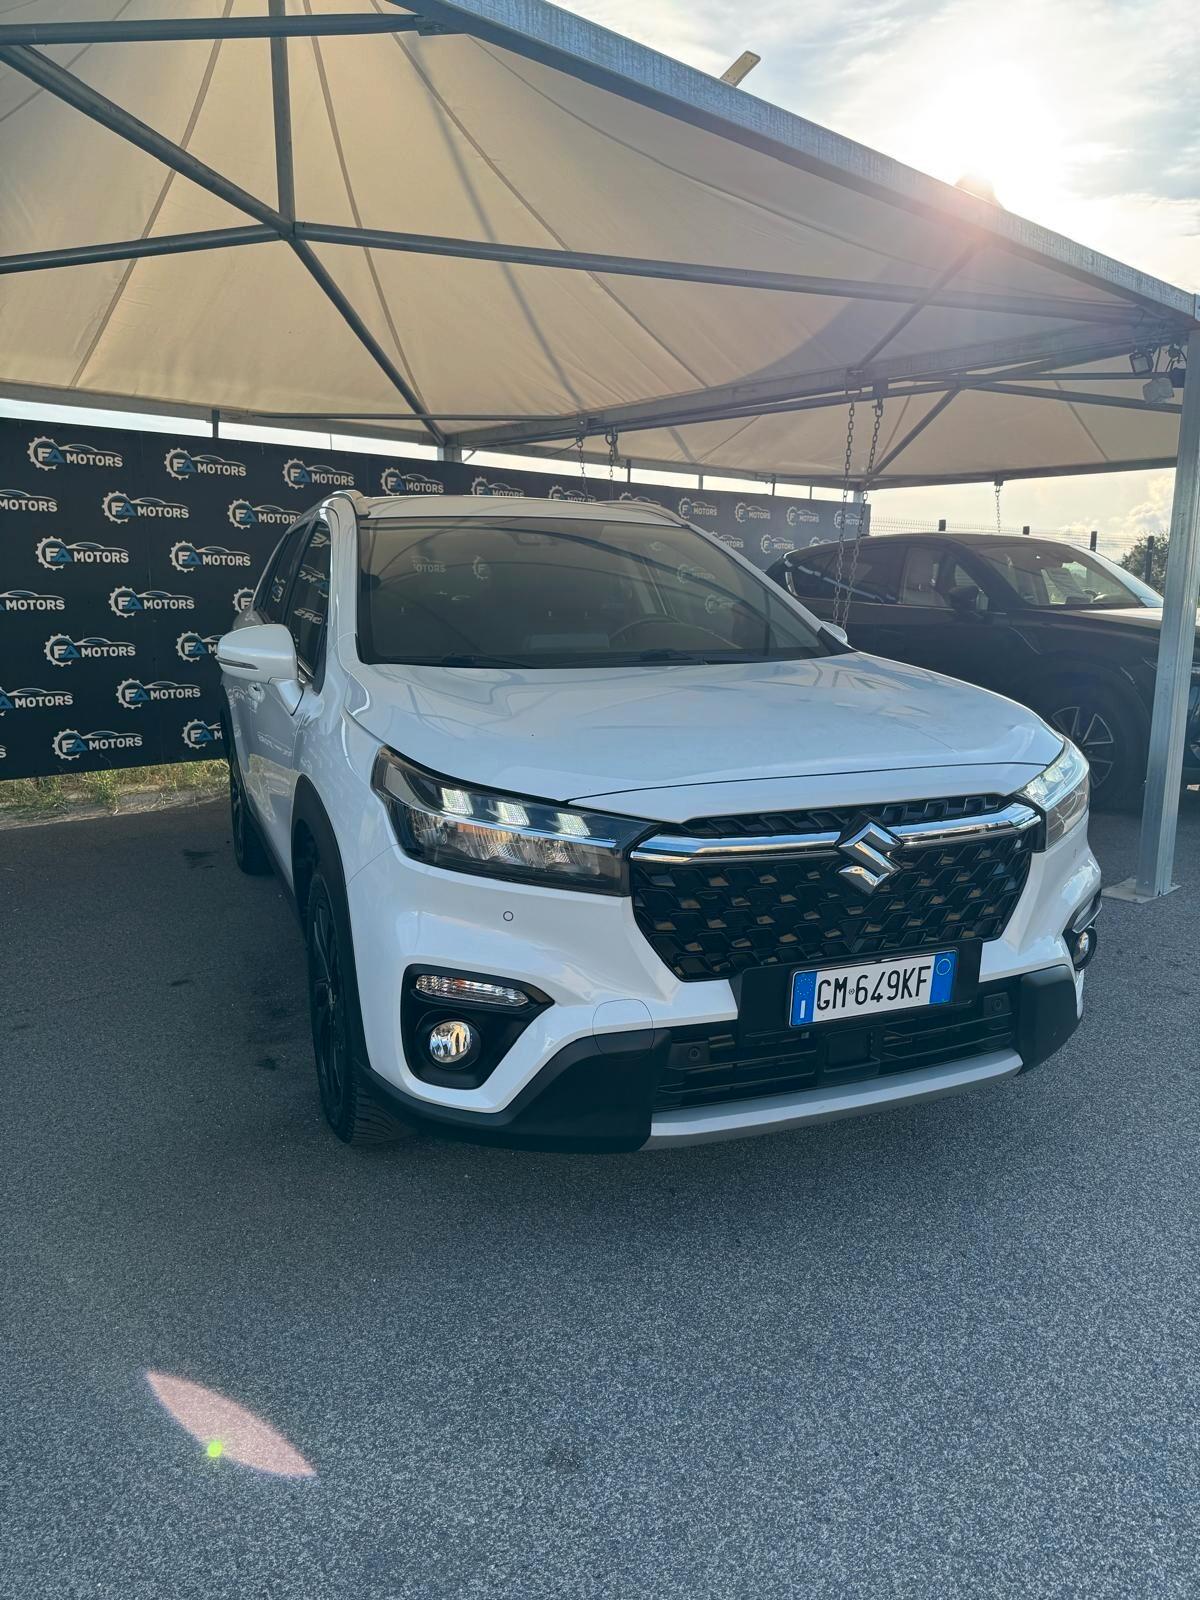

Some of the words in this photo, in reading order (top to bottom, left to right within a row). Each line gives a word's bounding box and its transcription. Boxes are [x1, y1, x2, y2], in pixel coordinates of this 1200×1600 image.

[38, 448, 65, 463] FA
[66, 453, 123, 468] MOTORS
[173, 459, 197, 473] FA
[197, 463, 247, 477] MOTORS
[290, 468, 311, 482] FA
[311, 473, 355, 486] MOTORS
[406, 482, 444, 494] MOTORS
[111, 503, 137, 517] FA
[137, 506, 189, 519] MOTORS
[235, 509, 258, 523] FA
[693, 507, 718, 516] MOTORS
[748, 511, 771, 520] MOTORS
[46, 548, 73, 562] FA
[73, 551, 129, 564] MOTORS
[178, 552, 202, 566] FA
[202, 554, 251, 567] MOTORS
[5, 600, 65, 610] MOTORS
[118, 597, 143, 610] FA
[143, 599, 195, 611] MOTORS
[54, 646, 80, 659] FA
[81, 646, 136, 658] MOTORS
[184, 642, 208, 655] FA
[15, 695, 74, 709] MOTORS
[124, 689, 150, 702] FA
[150, 688, 201, 700] MOTORS
[190, 729, 213, 742] FA
[61, 739, 88, 753] FA
[89, 736, 143, 751] MOTORS
